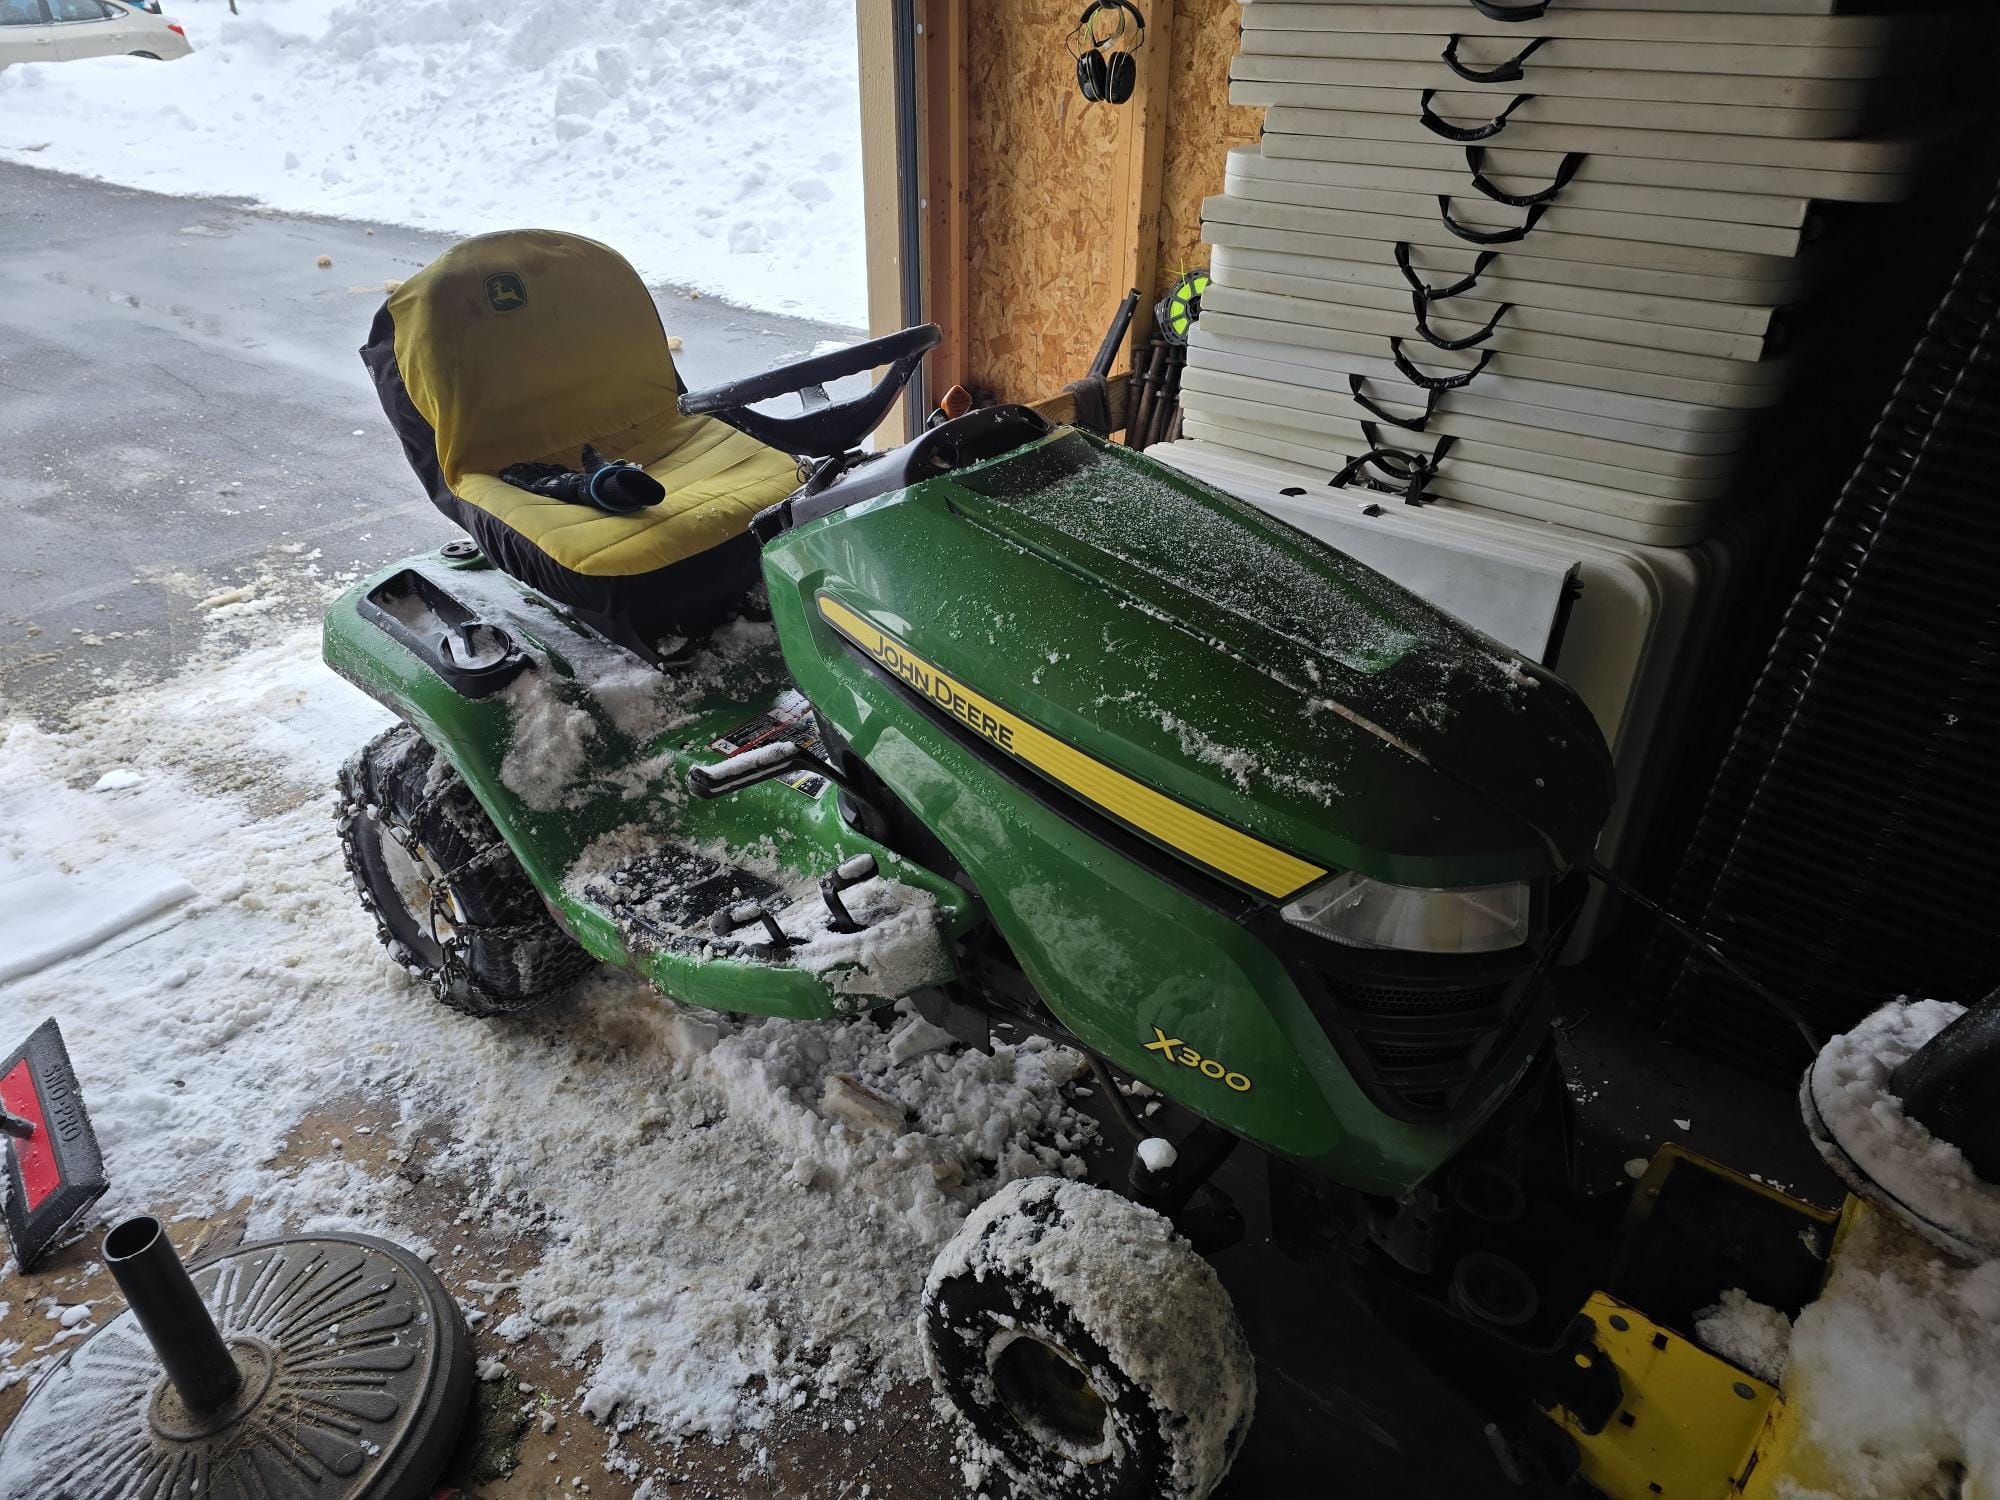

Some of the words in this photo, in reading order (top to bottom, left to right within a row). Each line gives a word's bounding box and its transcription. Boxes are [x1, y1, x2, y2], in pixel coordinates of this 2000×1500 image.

[872, 636, 930, 692] JOHN
[935, 676, 1014, 750] DEERE
[1142, 1024, 1252, 1092] X300
